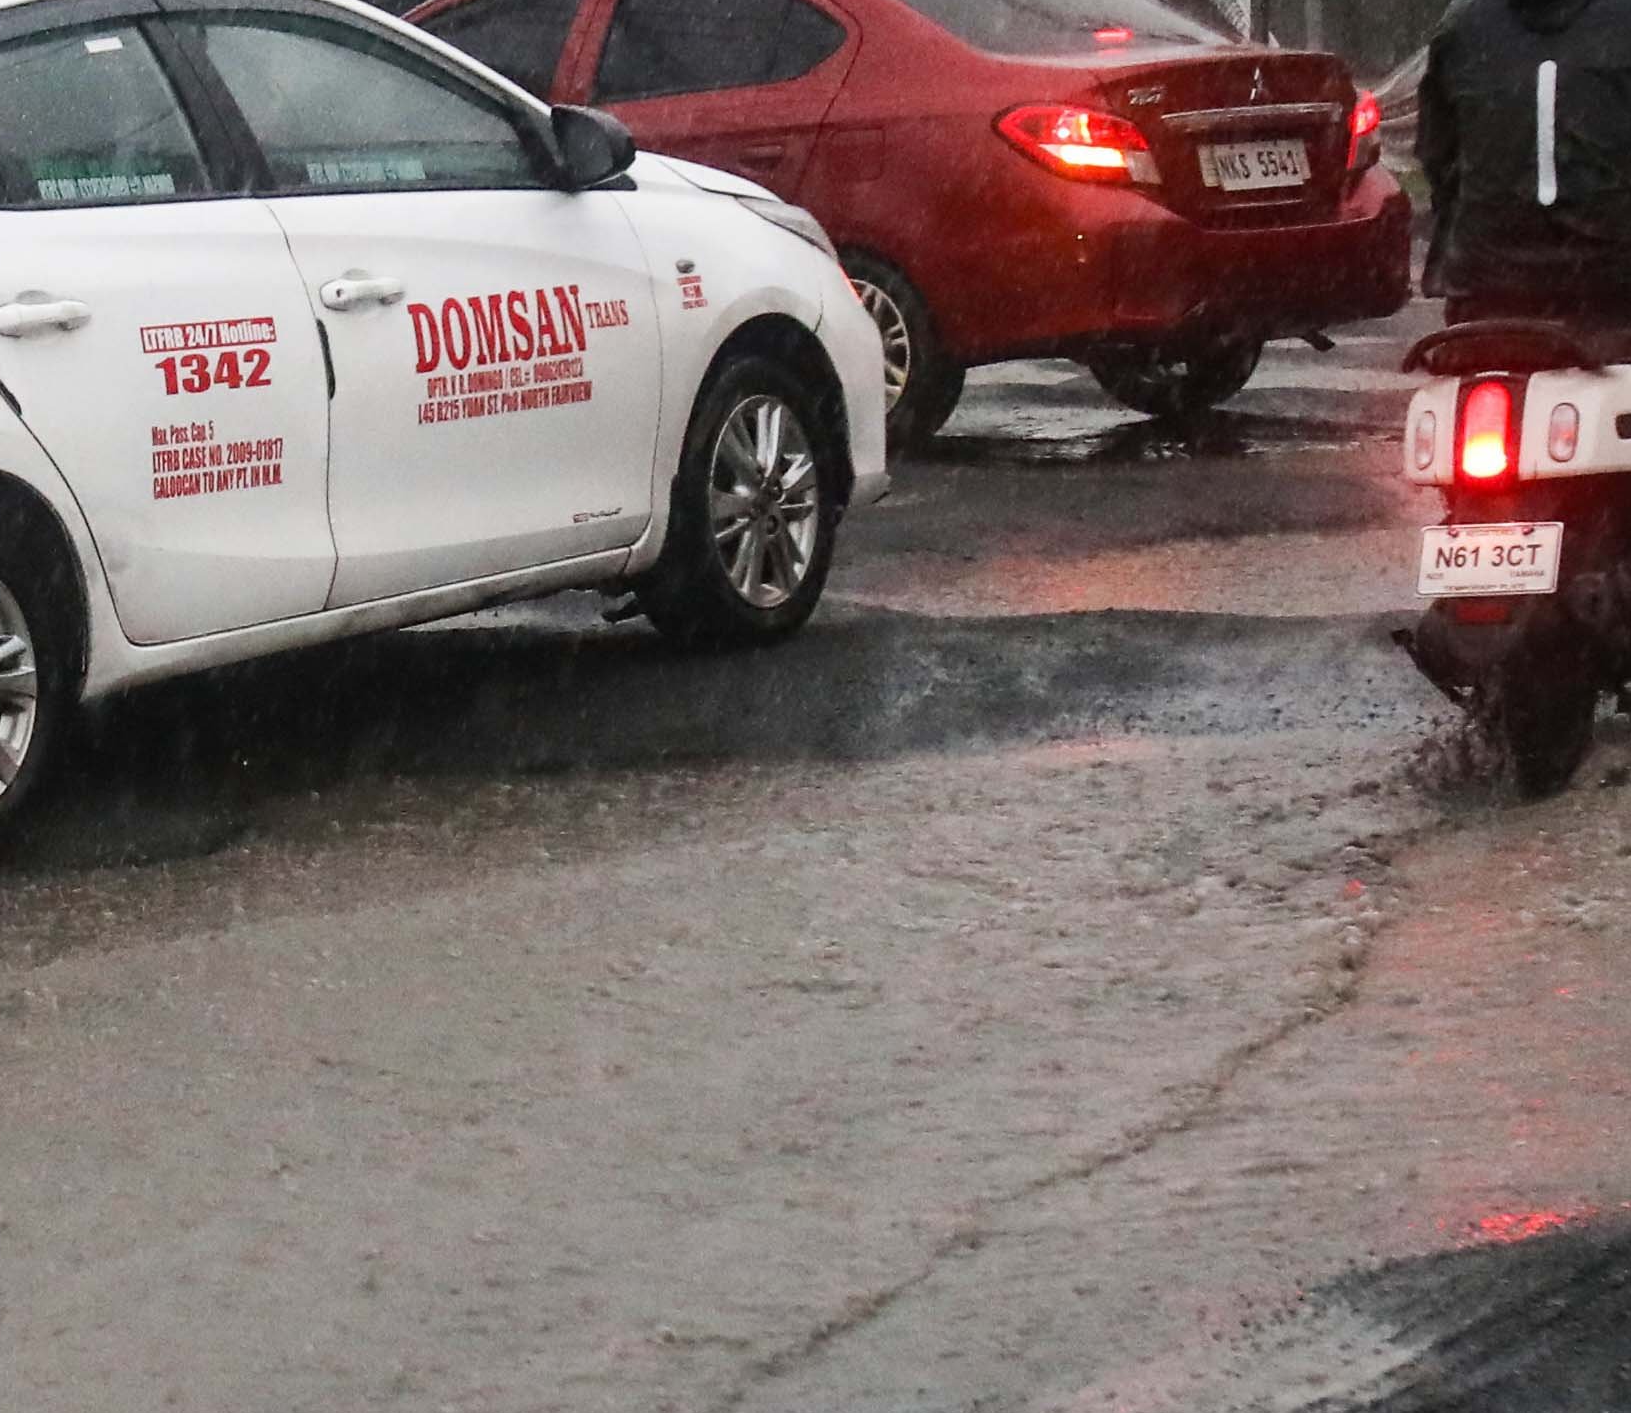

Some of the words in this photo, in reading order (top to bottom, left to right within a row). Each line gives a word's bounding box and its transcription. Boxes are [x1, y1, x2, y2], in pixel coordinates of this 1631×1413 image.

[142, 326, 185, 352] LTFRB
[219, 320, 275, 344] Hotline:
[407, 284, 587, 374] DOMSAN
[586, 300, 629, 329] TRANS
[154, 349, 272, 395] 1342
[208, 420, 214, 441] 5
[152, 449, 181, 474] LTFRB
[182, 445, 207, 471] CASE
[209, 443, 225, 467] NO.
[153, 472, 201, 500] CALOOCAN
[203, 471, 215, 493] TO
[216, 468, 235, 493] ANY
[250, 465, 260, 488] IN
[1435, 546, 1481, 569] N61
[1491, 543, 1543, 567] 3CT
